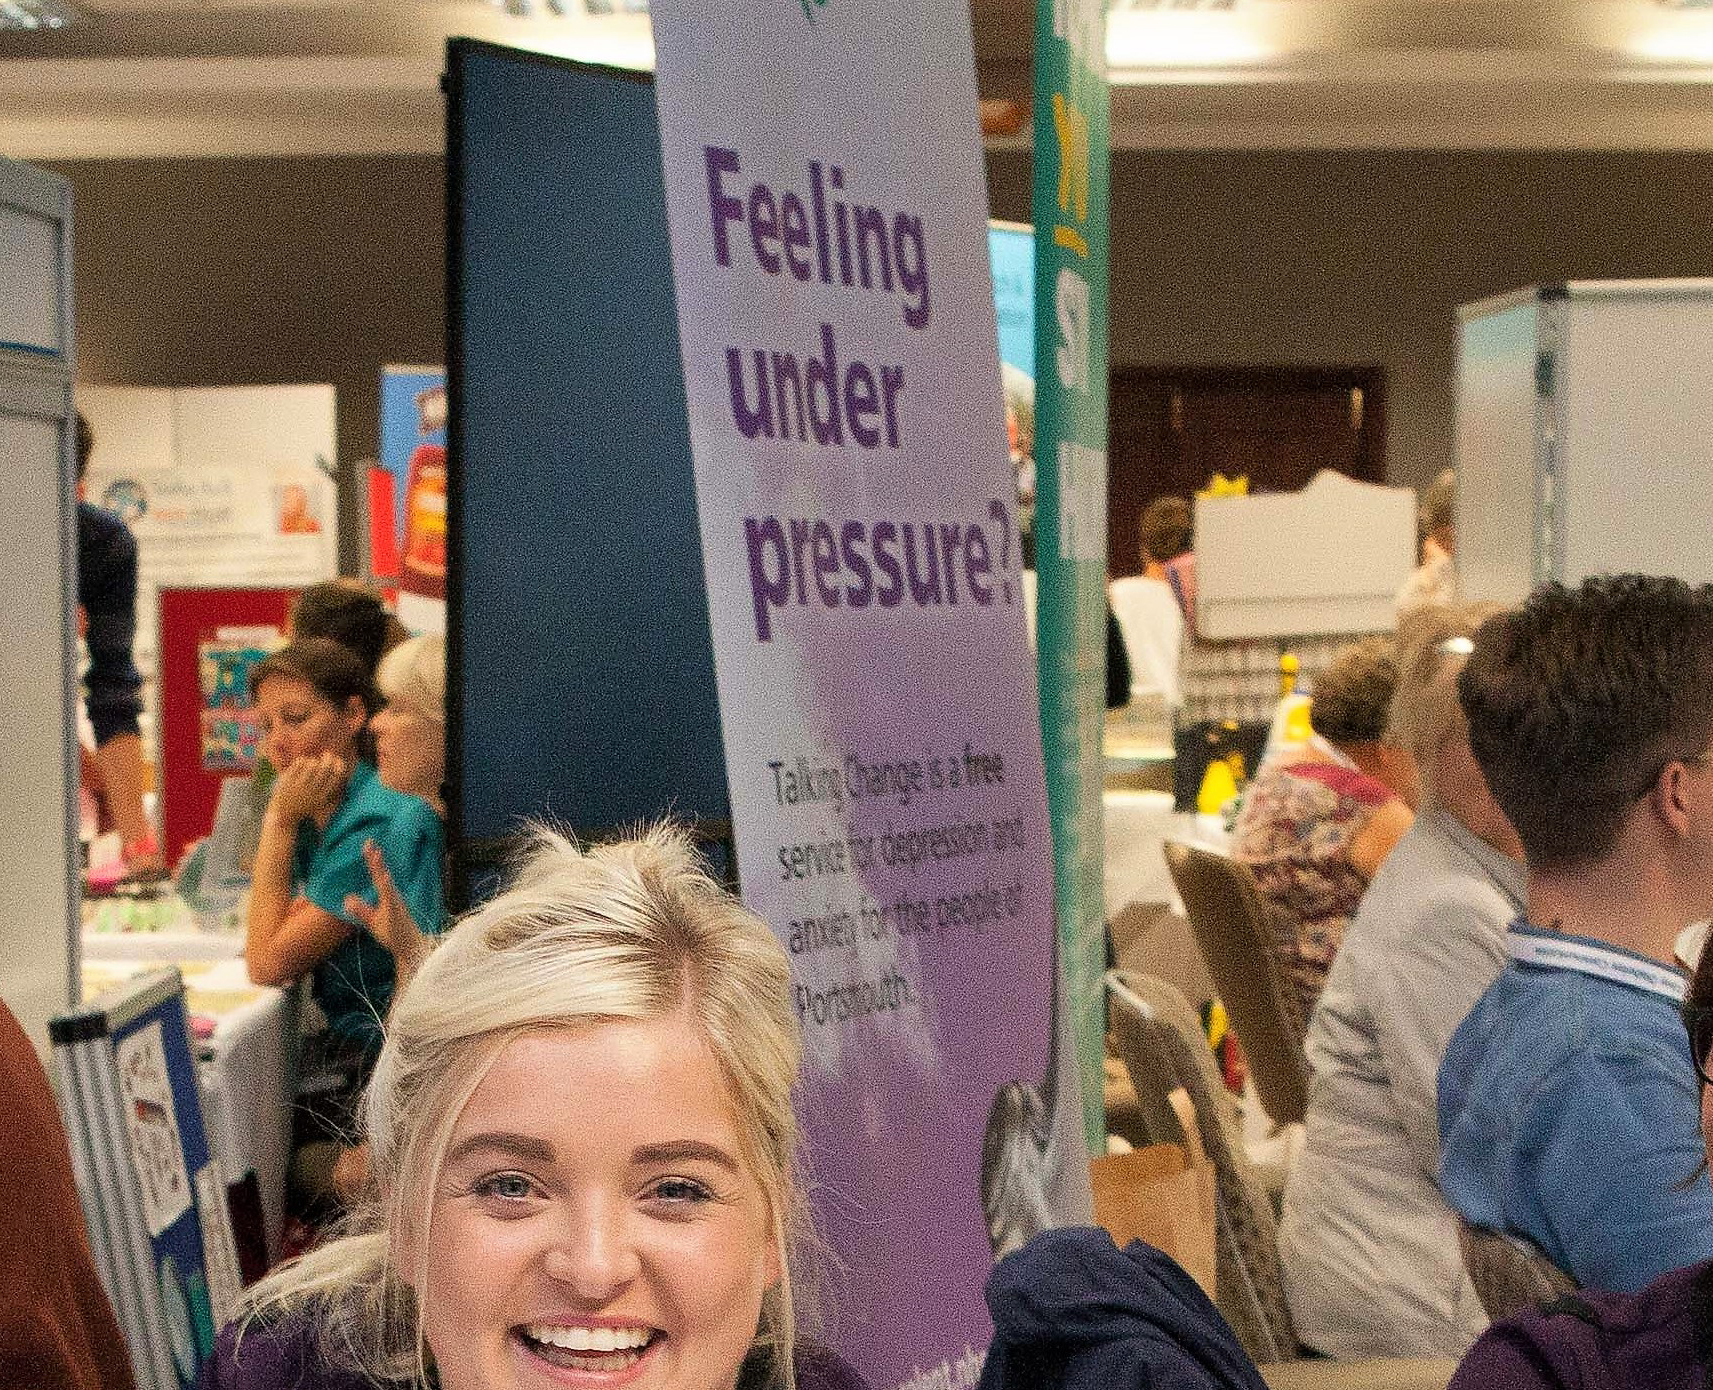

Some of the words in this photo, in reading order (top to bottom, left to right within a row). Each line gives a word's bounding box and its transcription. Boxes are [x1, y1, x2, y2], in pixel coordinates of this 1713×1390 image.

[704, 146, 932, 328] Feeling
[726, 325, 904, 448] under
[743, 500, 1013, 642] pressure?
[767, 757, 844, 812] Talking
[844, 754, 922, 806] Change
[928, 752, 944, 789] is
[945, 764, 961, 788] a
[963, 742, 1004, 785] free
[777, 829, 847, 881] service
[847, 824, 877, 869] for
[882, 816, 989, 876] depression
[991, 810, 1026, 850] and
[859, 895, 892, 940] for
[893, 890, 931, 935] the
[935, 879, 1001, 936] people
[1004, 882, 1024, 921] of
